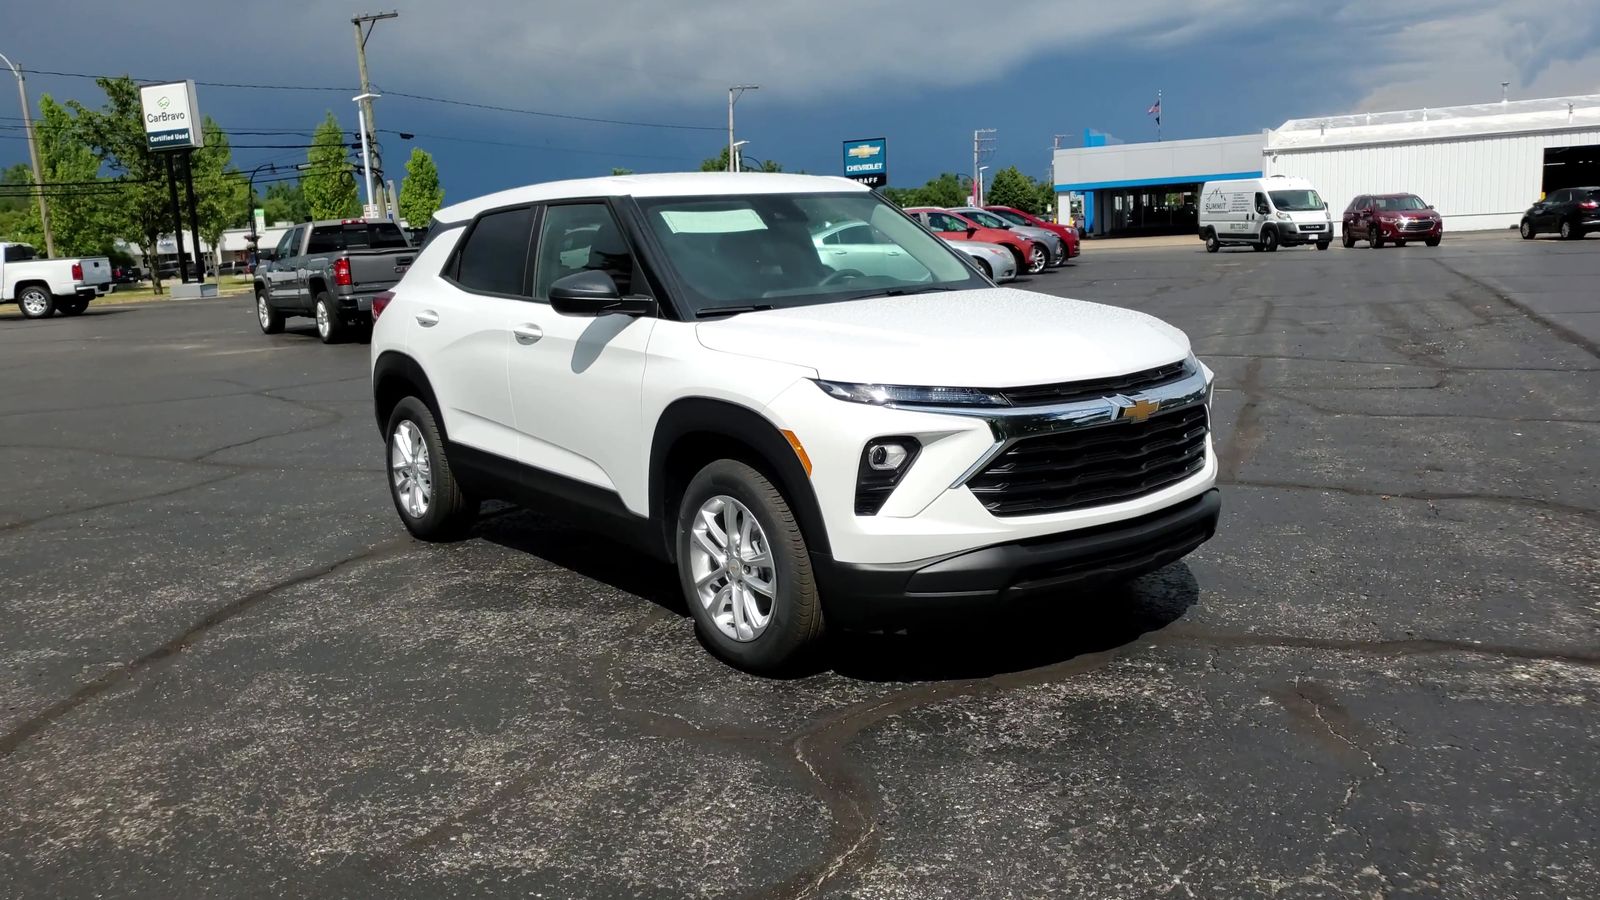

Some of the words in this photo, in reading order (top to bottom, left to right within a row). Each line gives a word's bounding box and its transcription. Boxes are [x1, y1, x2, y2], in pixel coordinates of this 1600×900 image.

[147, 112, 185, 123] CarBravo
[150, 134, 174, 142] Certified
[175, 132, 189, 140] Used
[847, 162, 883, 172] CHEVROLET
[1205, 202, 1226, 210] SUMMIT
